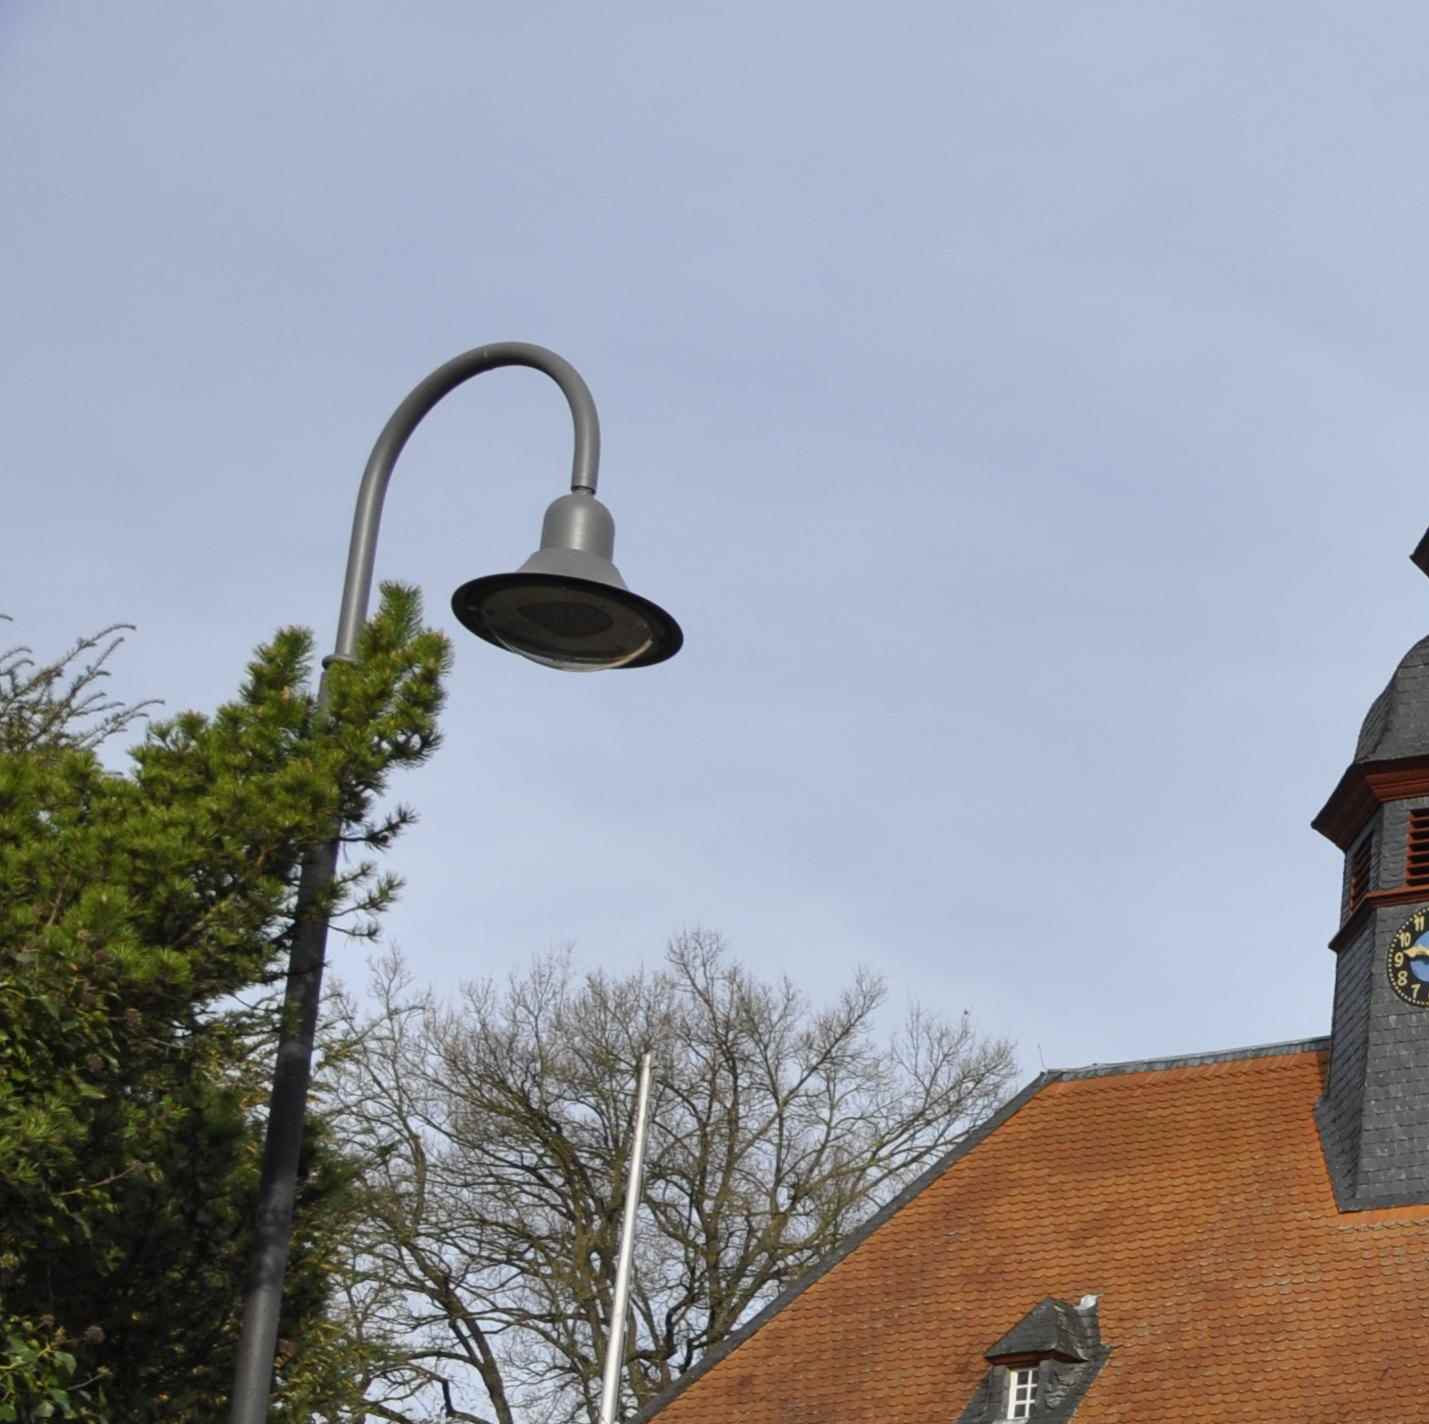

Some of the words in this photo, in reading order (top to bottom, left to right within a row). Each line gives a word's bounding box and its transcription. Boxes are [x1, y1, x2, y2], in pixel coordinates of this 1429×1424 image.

[1414, 915, 1425, 931] 11
[1400, 932, 1411, 948] 10
[1394, 952, 1404, 967] 9
[1397, 970, 1408, 986] 8
[1411, 983, 1421, 999] 7
